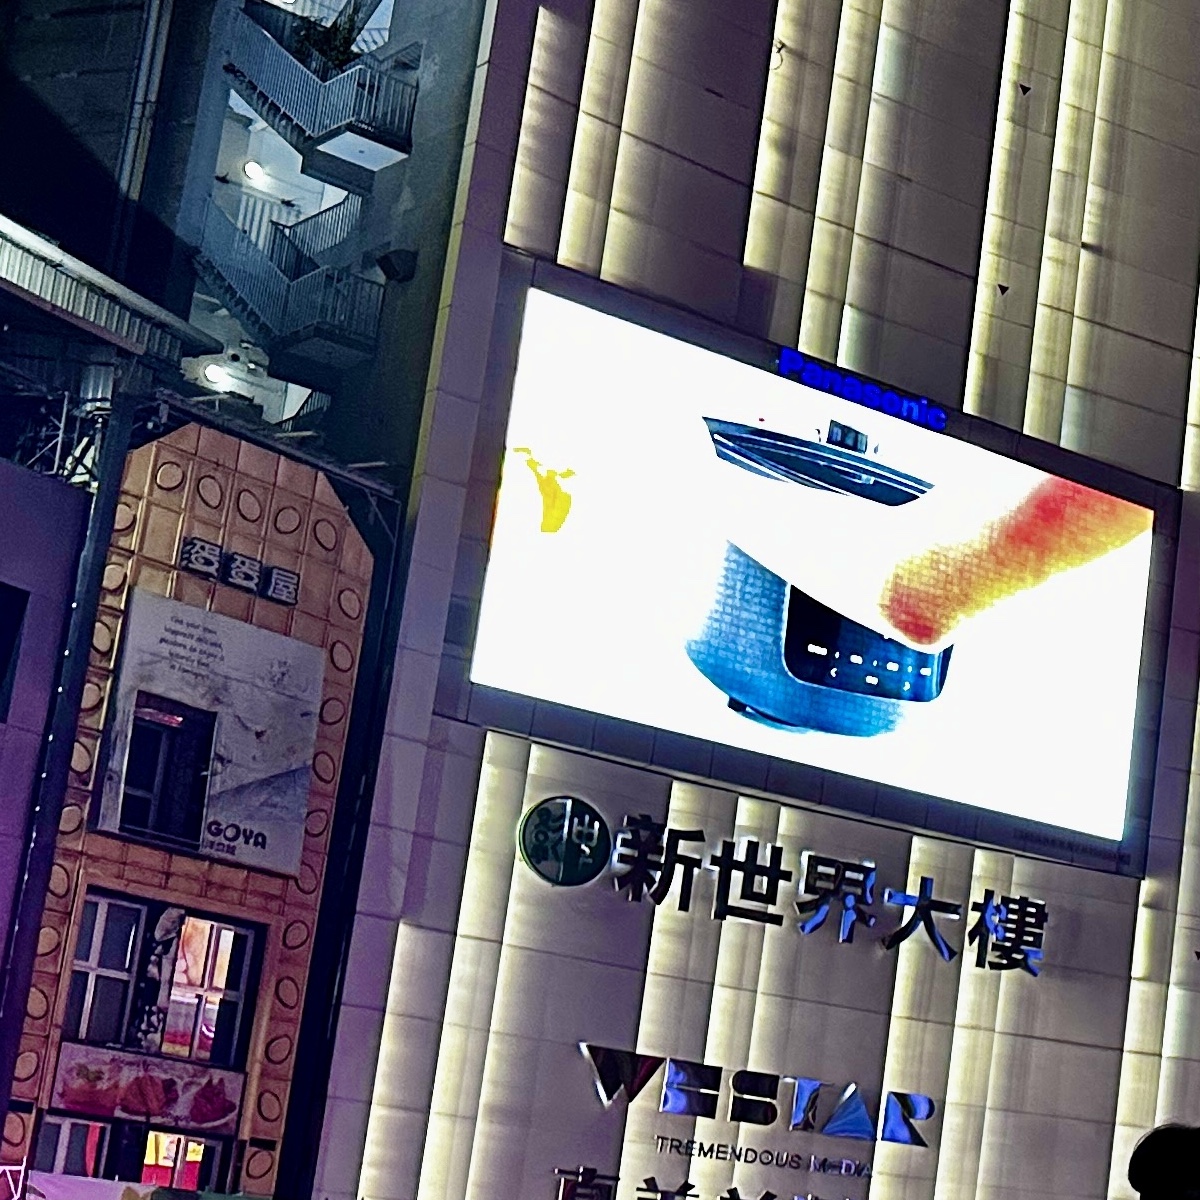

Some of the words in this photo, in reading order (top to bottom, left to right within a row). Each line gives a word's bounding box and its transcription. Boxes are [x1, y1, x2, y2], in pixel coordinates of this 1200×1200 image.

[778, 345, 948, 432] Panasonic
[207, 820, 267, 850] GOYA
[612, 814, 1049, 978] 新世界大樓
[579, 1042, 936, 1147] WESTAR
[656, 1134, 801, 1169] TREMENDOUS
